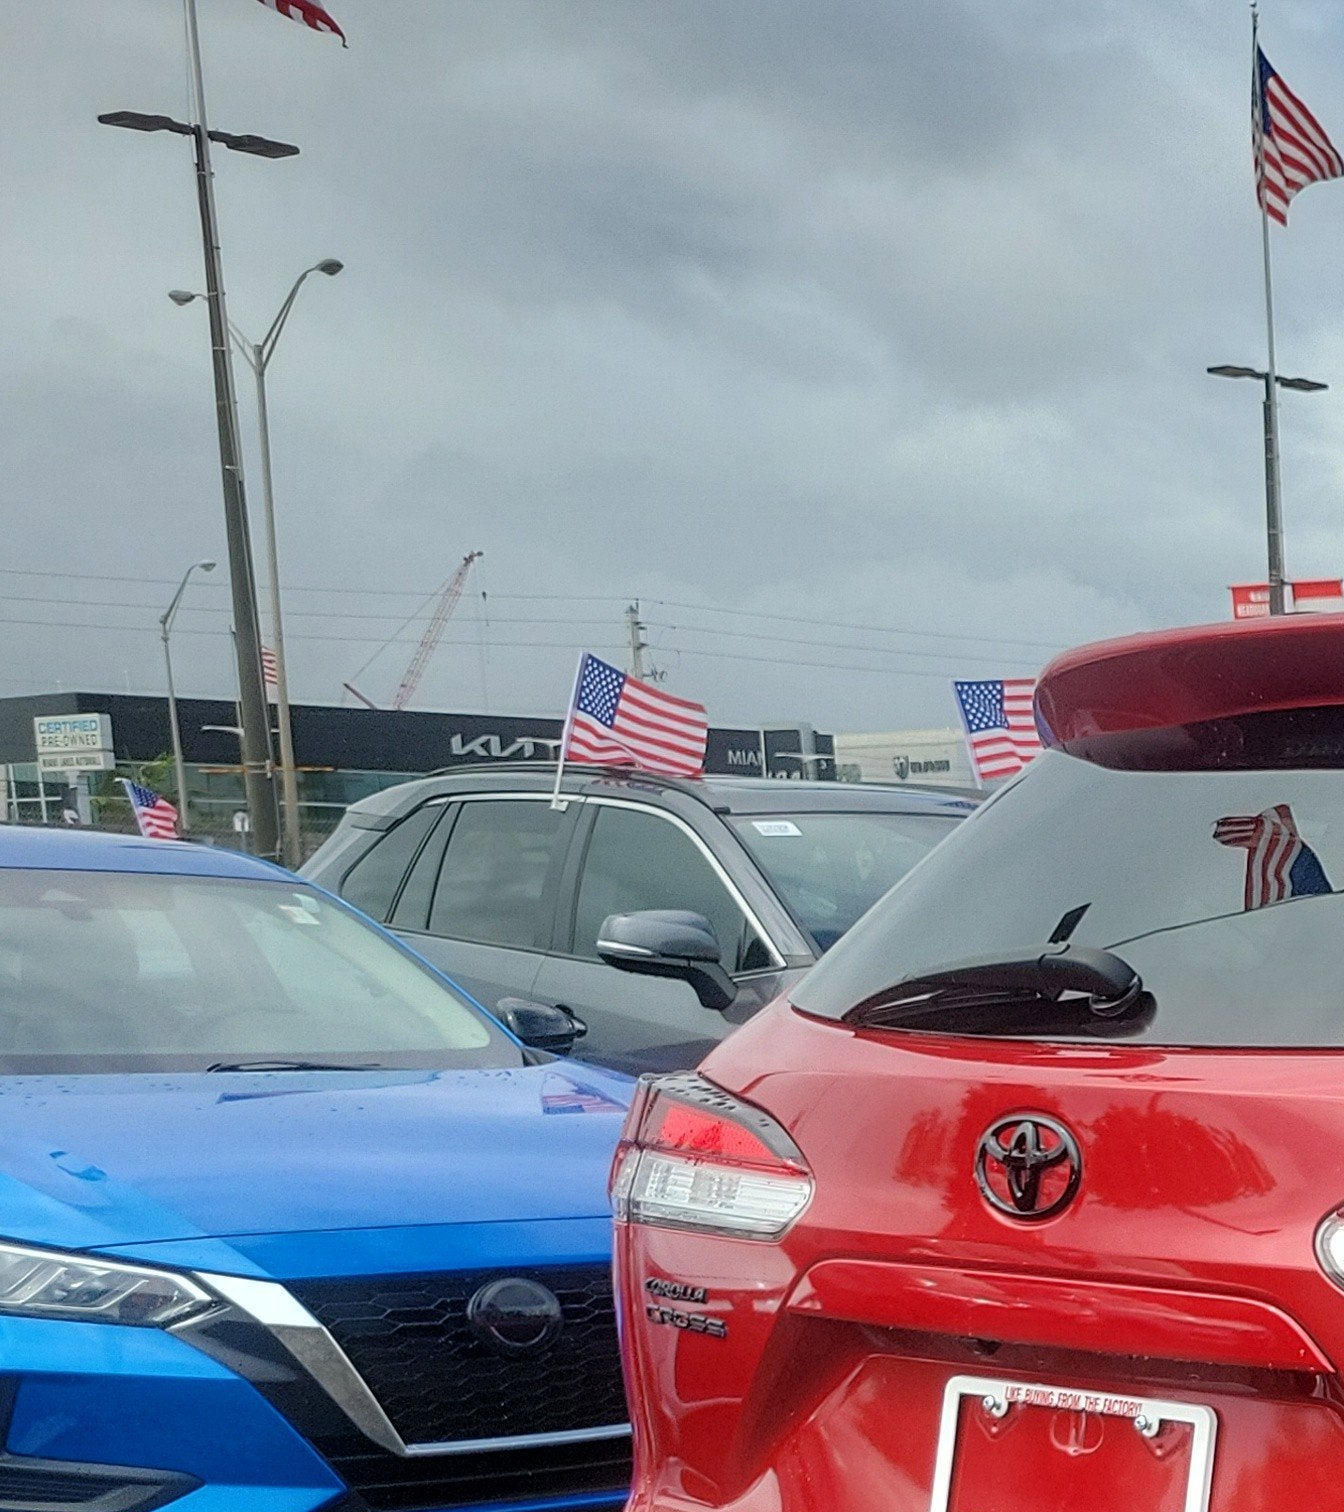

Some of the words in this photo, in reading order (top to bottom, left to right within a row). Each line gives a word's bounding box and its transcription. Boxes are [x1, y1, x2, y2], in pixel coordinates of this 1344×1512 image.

[38, 720, 98, 734] CERTIFIED
[41, 734, 98, 747] PRE-OWNED
[645, 1277, 708, 1303] COROLLA
[646, 1304, 727, 1339] CROSS
[1005, 1385, 1023, 1401] LIKE
[1024, 1388, 1054, 1405] BUYING
[1057, 1392, 1081, 1409] FROM
[1084, 1395, 1100, 1412] THE
